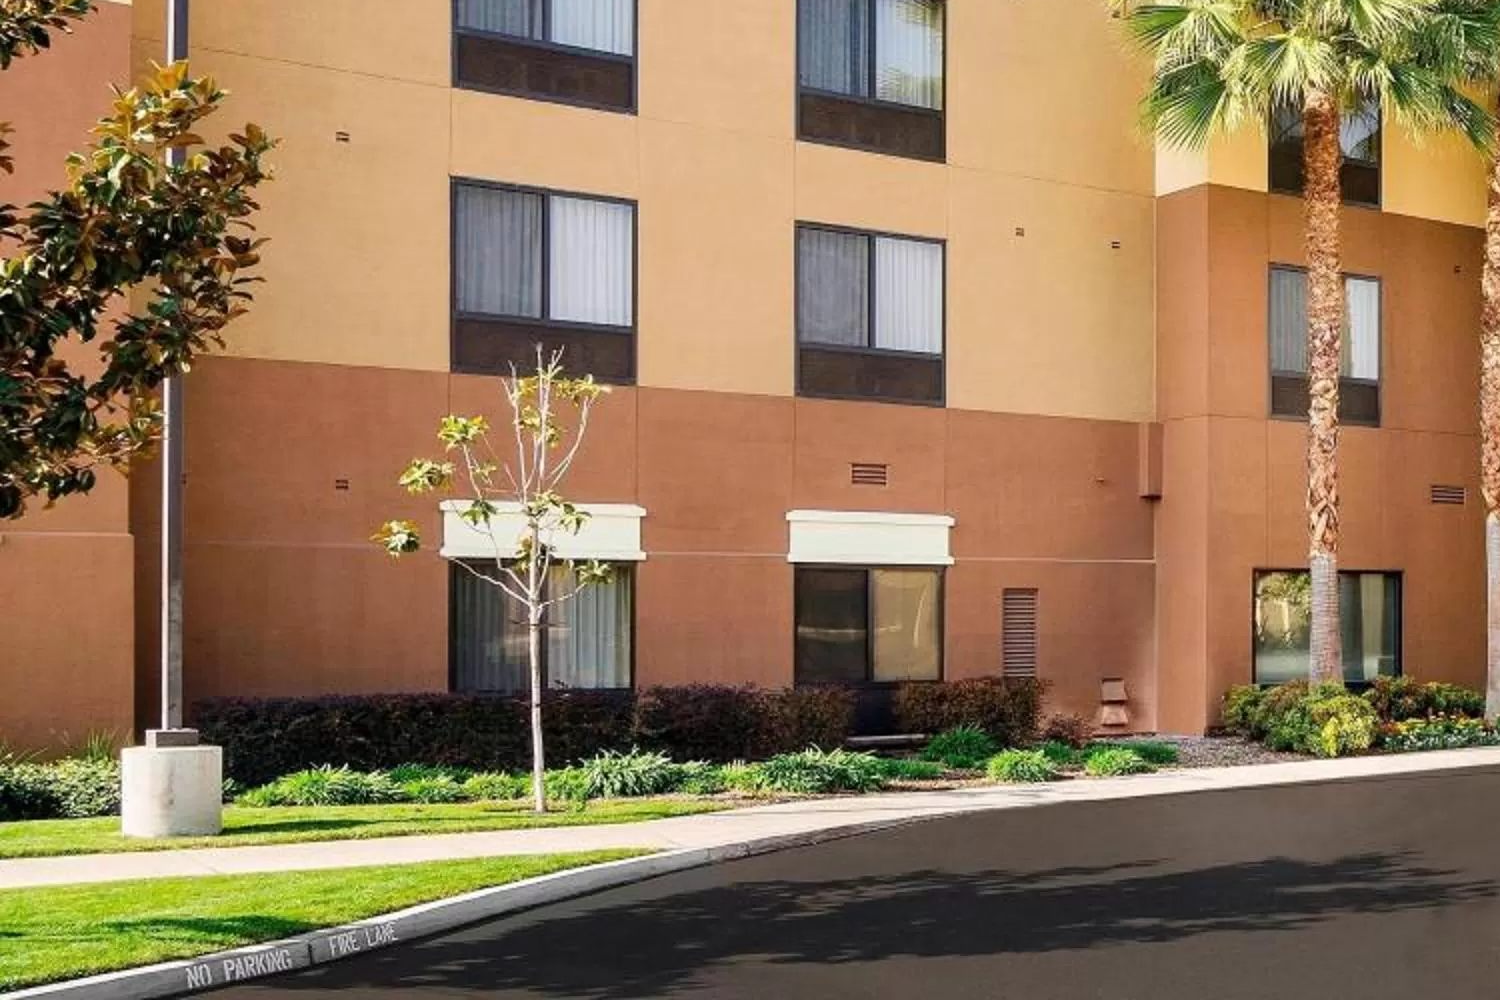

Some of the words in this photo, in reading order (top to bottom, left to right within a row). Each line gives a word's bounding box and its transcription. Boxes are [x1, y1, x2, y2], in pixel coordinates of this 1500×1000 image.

[185, 964, 211, 989] NO
[223, 950, 293, 981] PARKING
[328, 932, 360, 957] FIRE
[365, 921, 399, 947] LANE
